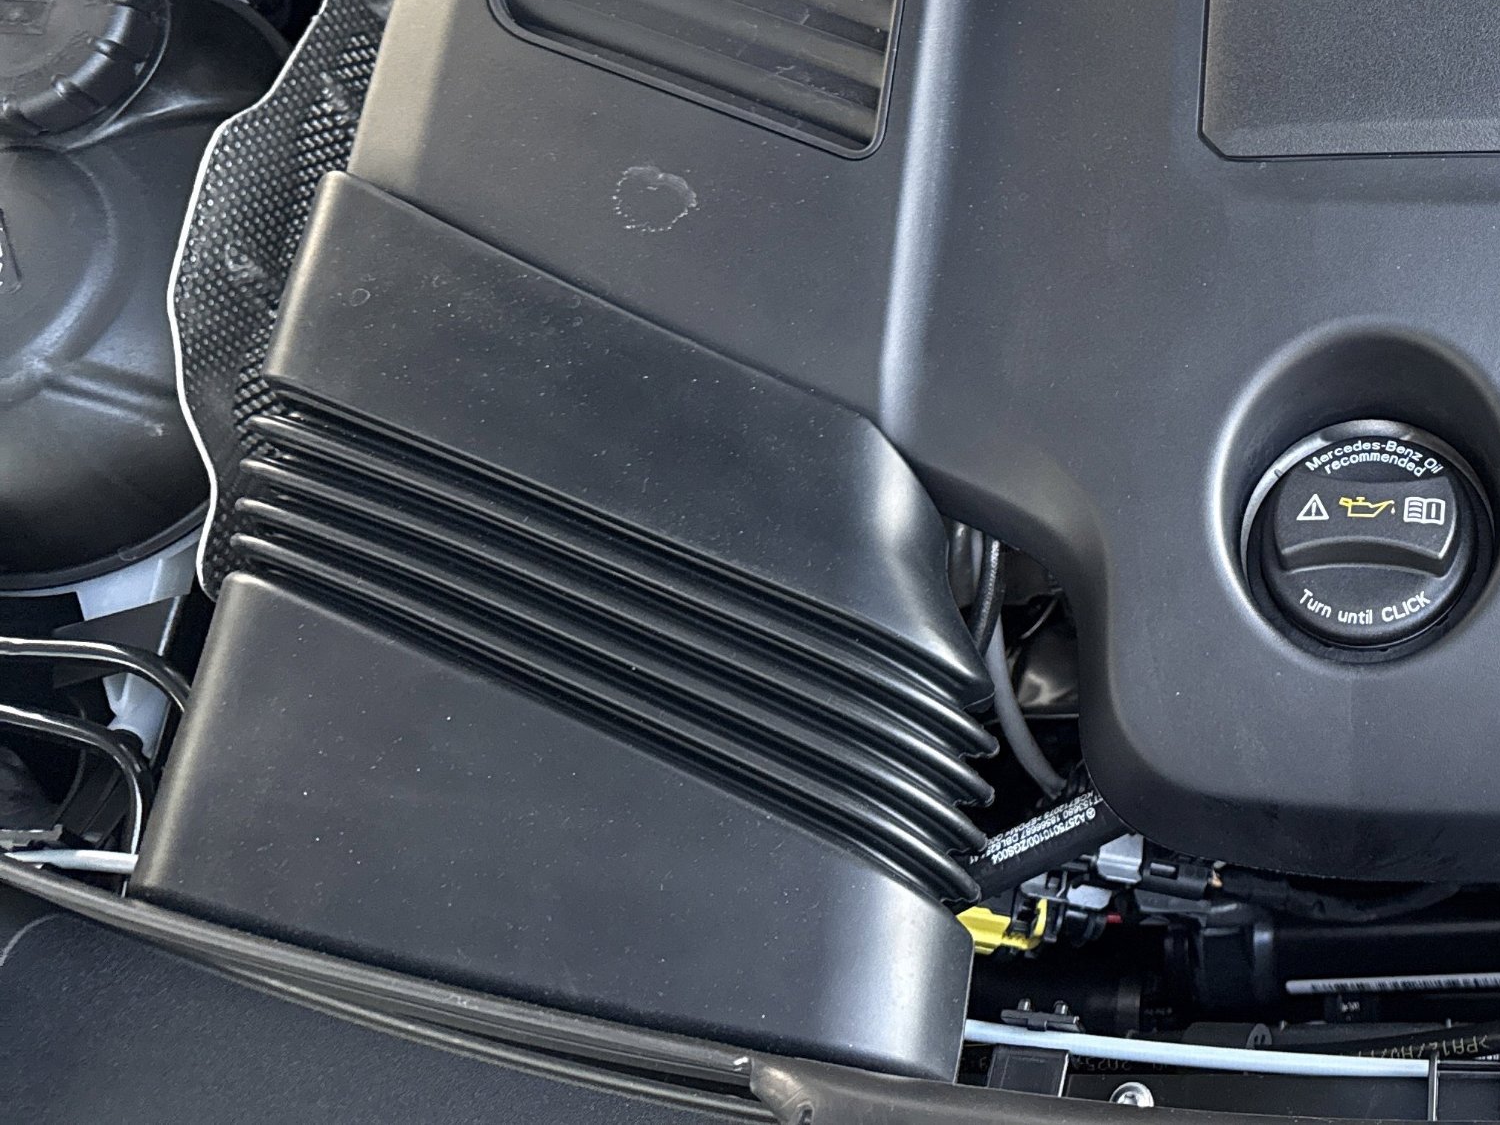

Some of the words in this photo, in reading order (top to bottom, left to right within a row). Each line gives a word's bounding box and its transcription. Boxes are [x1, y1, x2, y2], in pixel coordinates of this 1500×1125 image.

[1304, 440, 1424, 472] Mercedes-Benz
[1423, 457, 1445, 475] Oil
[1324, 452, 1427, 478] recommended
[1299, 588, 1333, 619] Turn
[1337, 609, 1374, 626] until
[1381, 591, 1432, 623] CLICK
